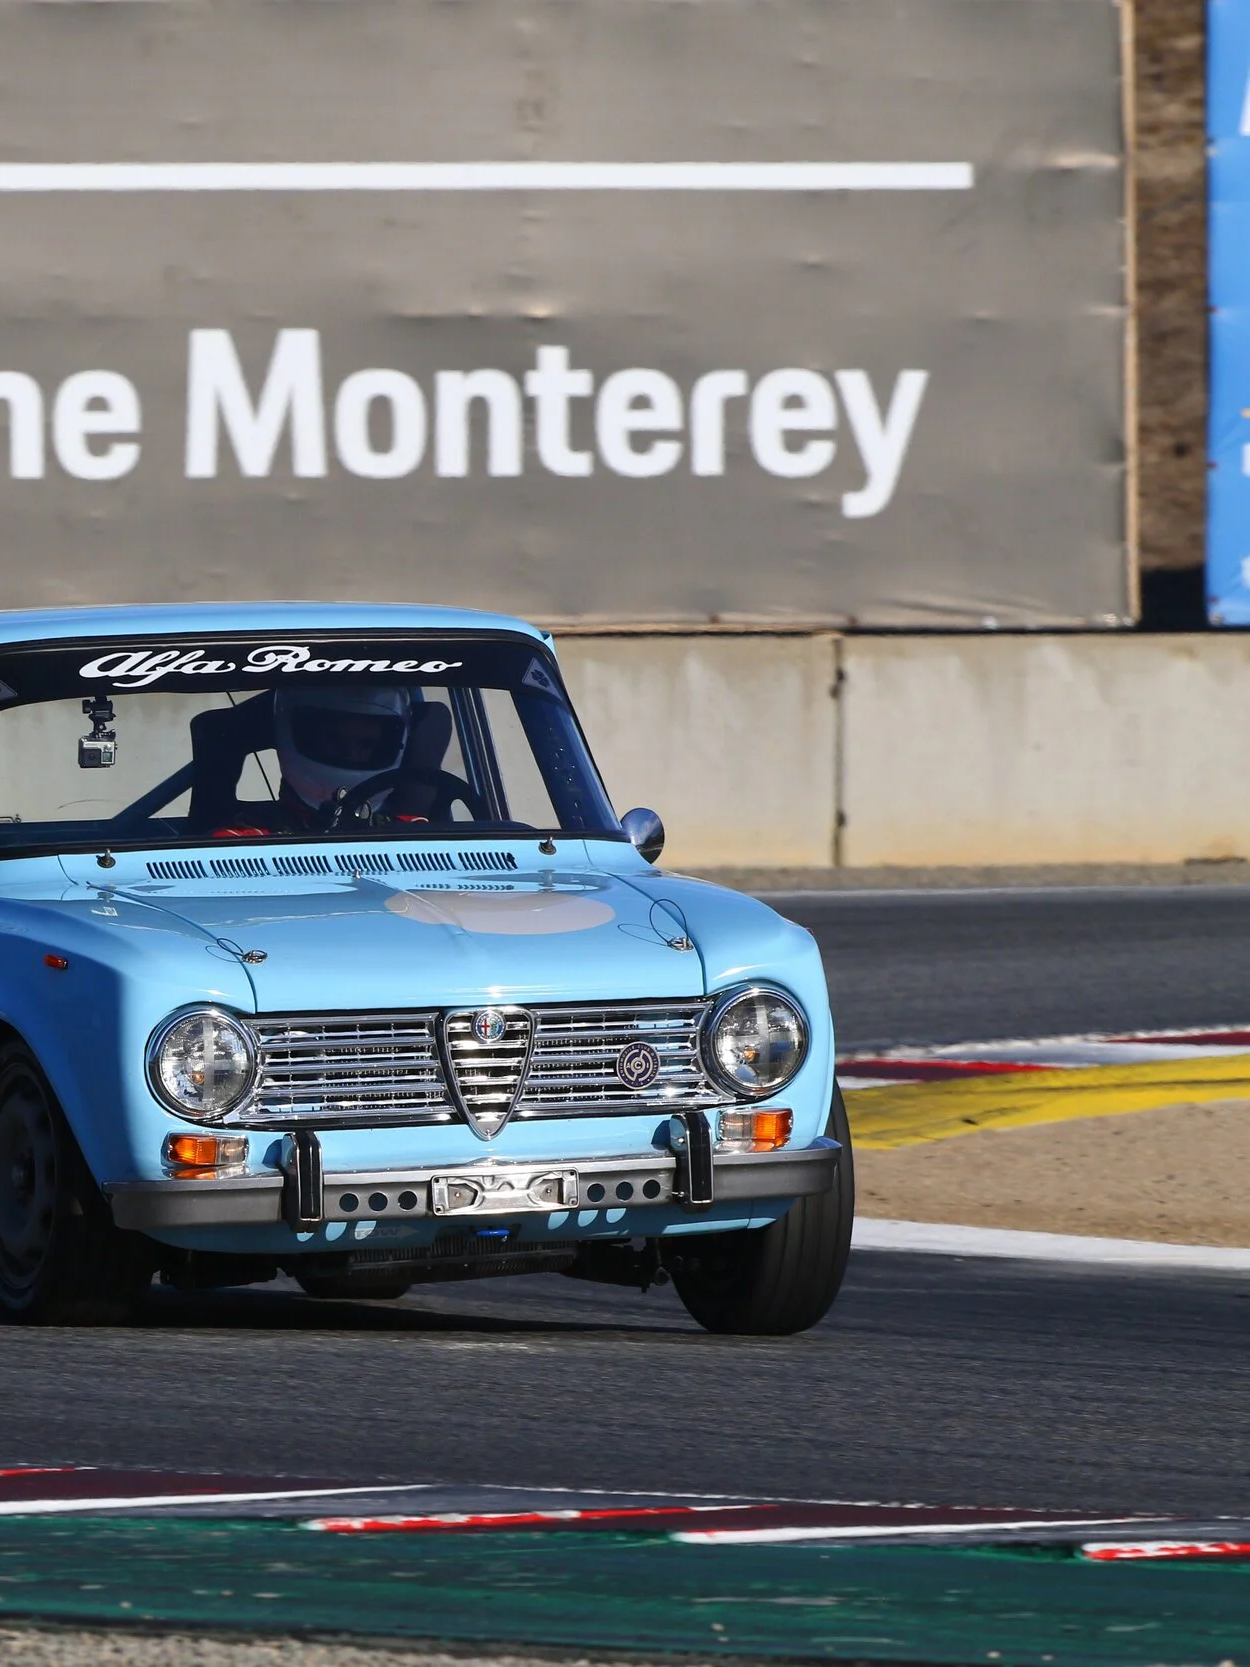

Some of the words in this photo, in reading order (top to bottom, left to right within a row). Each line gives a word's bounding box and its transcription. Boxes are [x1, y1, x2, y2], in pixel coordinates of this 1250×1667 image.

[184, 328, 928, 518] Monterey
[79, 650, 235, 688] Alfa
[241, 645, 463, 673] Romeo
